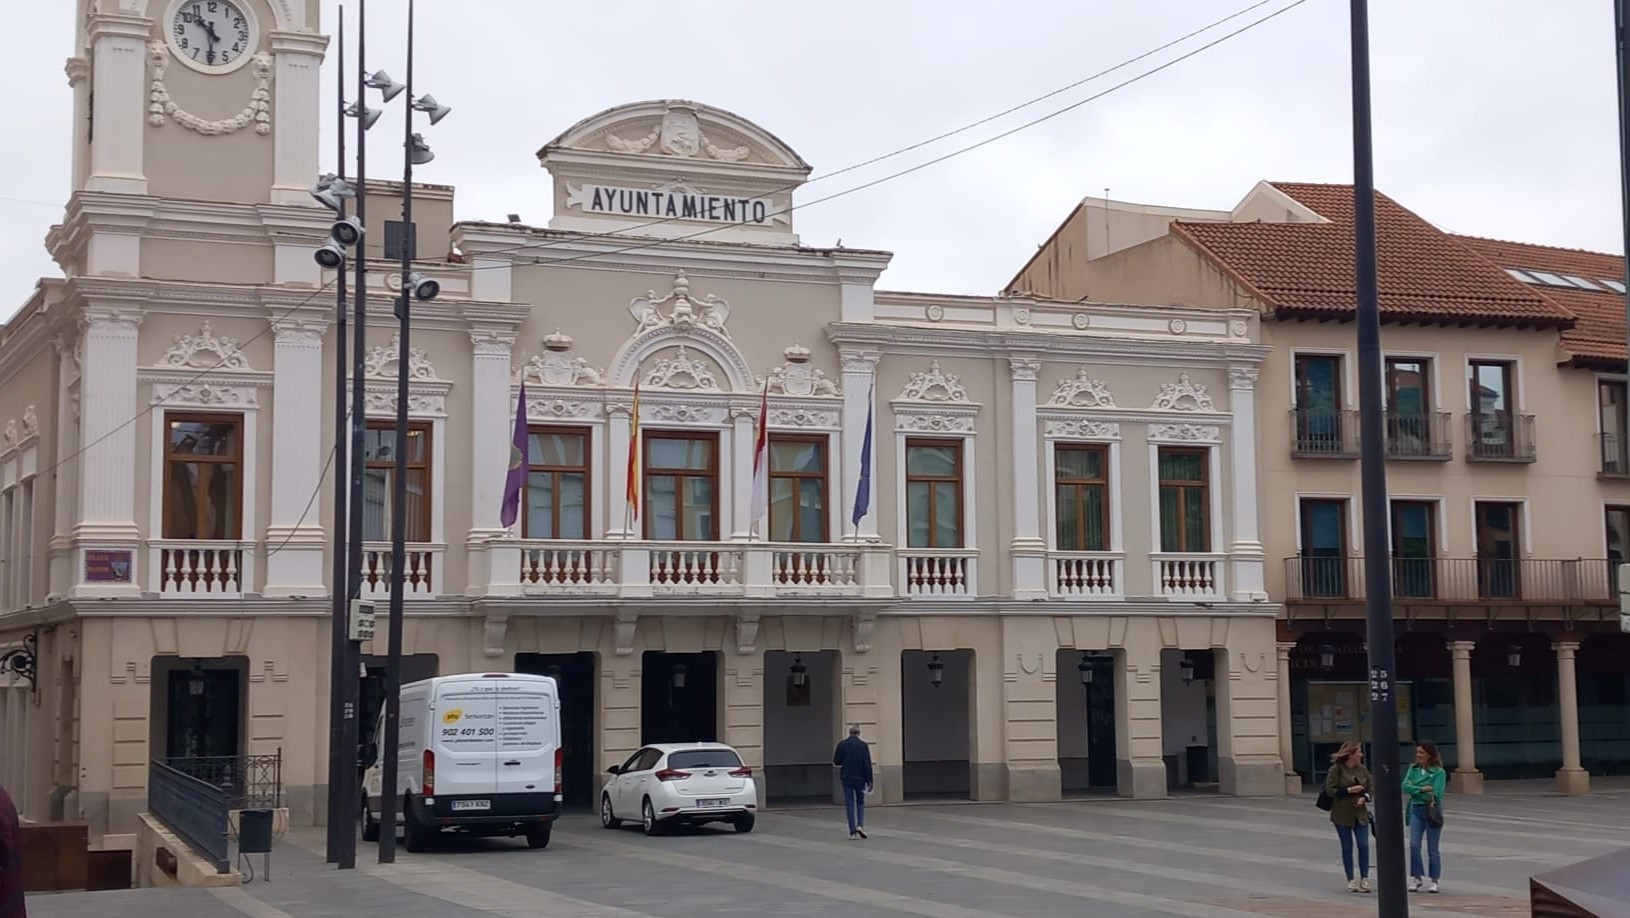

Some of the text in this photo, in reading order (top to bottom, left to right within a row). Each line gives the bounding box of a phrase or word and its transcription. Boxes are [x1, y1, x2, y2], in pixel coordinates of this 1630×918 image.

[207, 2, 218, 13] 12
[225, 7, 229, 18] 1
[233, 17, 240, 29] 2
[177, 24, 184, 35] 9
[238, 30, 245, 41] 3
[182, 38, 188, 49] 8
[232, 42, 239, 52] 4
[193, 47, 200, 60] 7
[222, 51, 229, 61] 5
[591, 187, 766, 223] AYUNTAMIENTO
[1370, 669, 1388, 679] 25
[1371, 681, 1389, 690] 26
[1371, 692, 1389, 702] 27
[441, 728, 458, 737] 902
[460, 728, 476, 736] 401
[477, 728, 495, 736] 500
